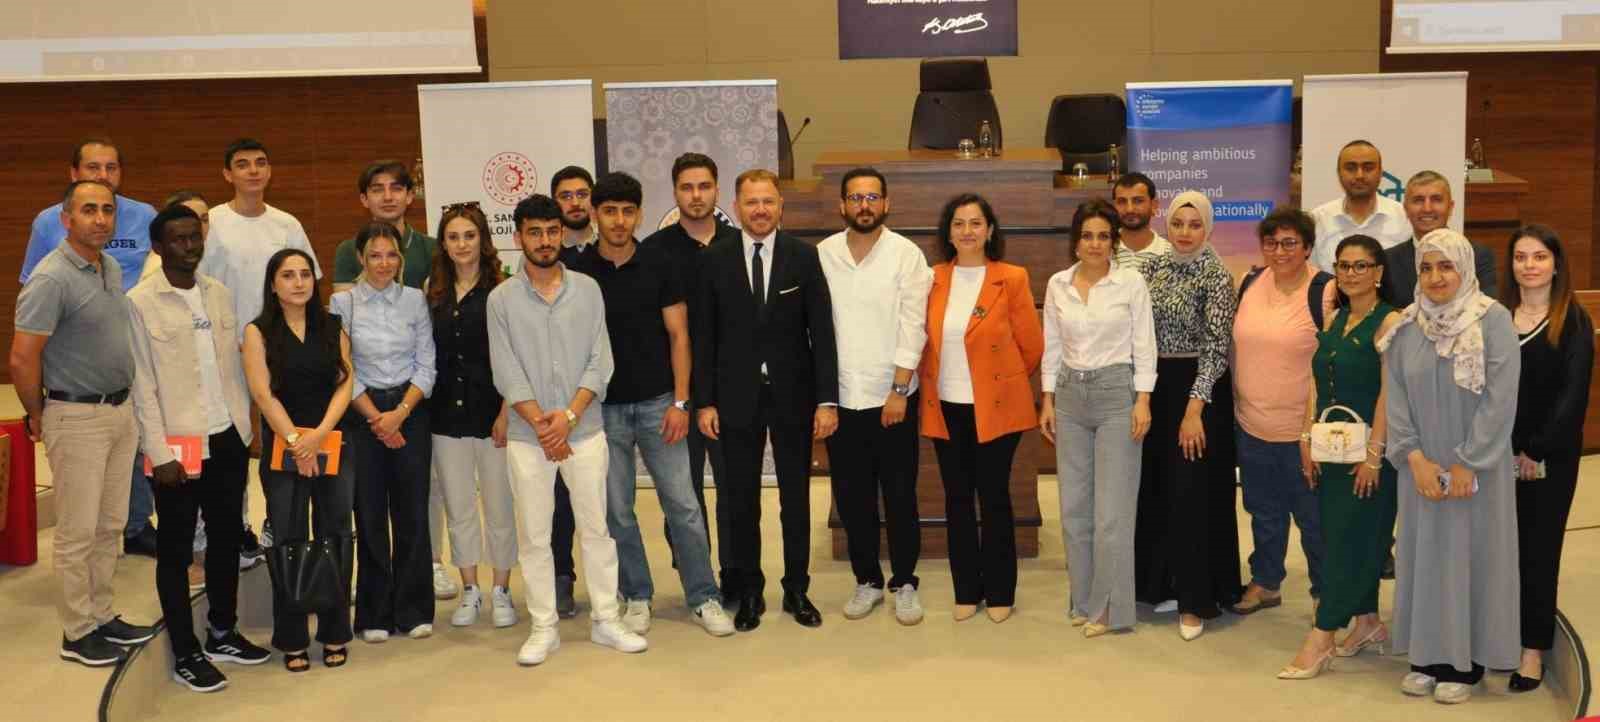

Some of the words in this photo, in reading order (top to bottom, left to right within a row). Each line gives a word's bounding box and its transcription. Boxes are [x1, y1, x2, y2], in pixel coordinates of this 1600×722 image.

[1141, 149, 1188, 164] Helping
[1192, 147, 1256, 161] ambitious
[1211, 203, 1269, 219] nationally
[494, 214, 513, 222] SAN
[104, 239, 137, 249] AGER
